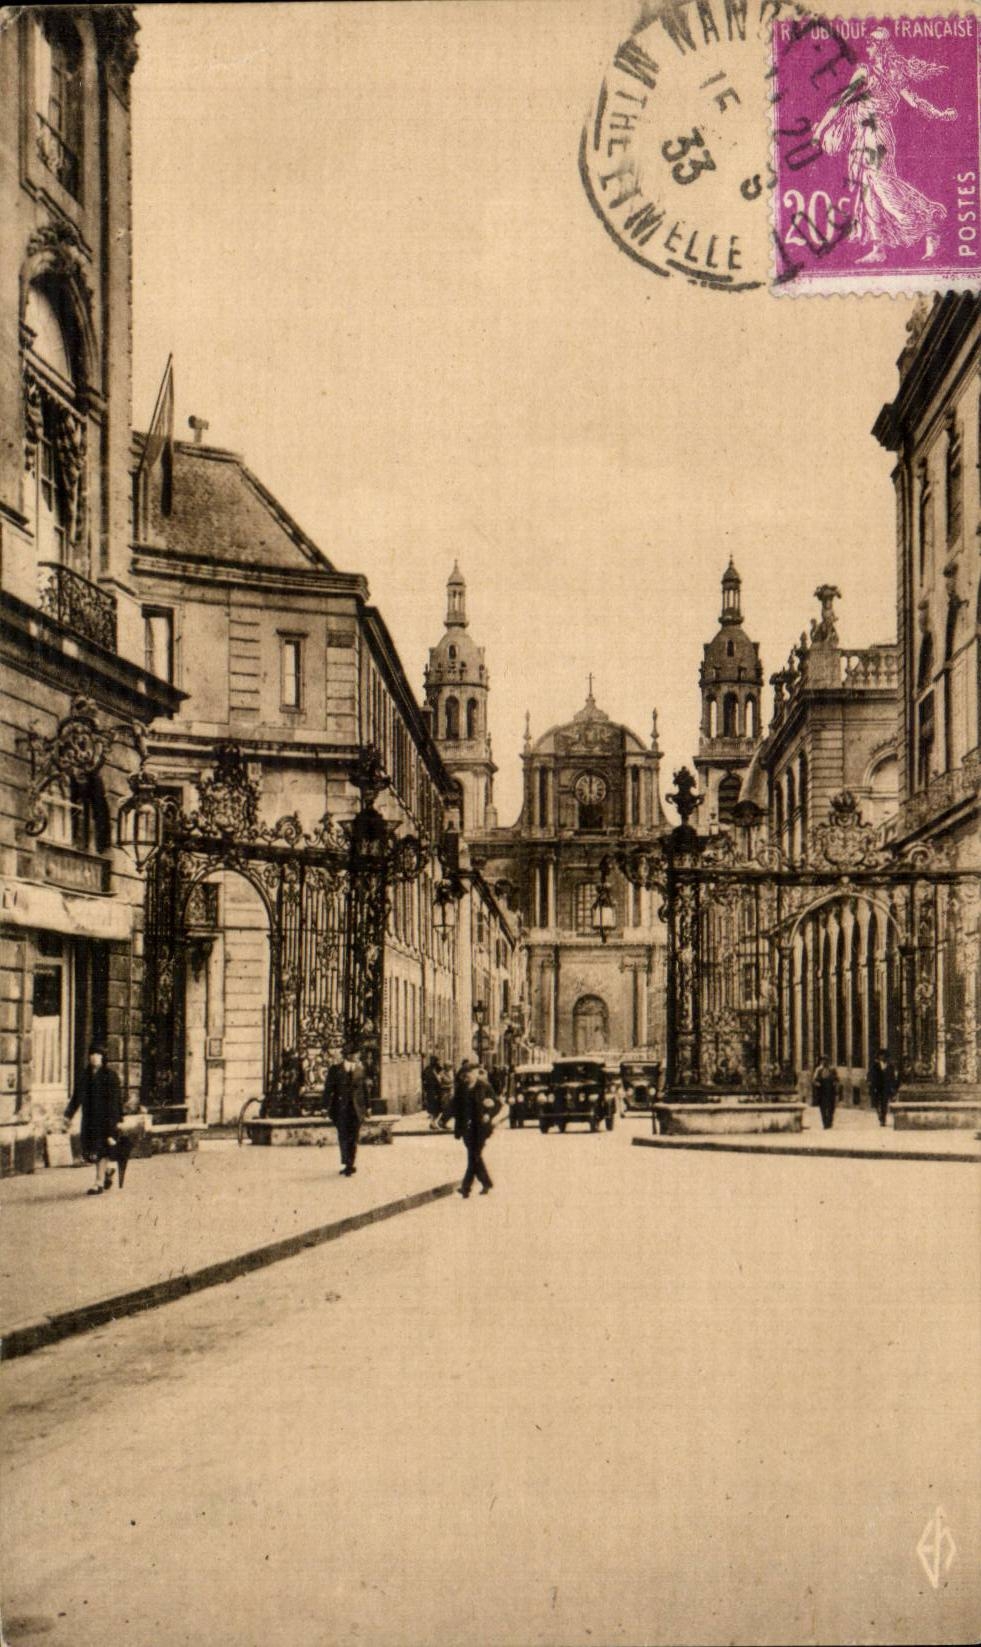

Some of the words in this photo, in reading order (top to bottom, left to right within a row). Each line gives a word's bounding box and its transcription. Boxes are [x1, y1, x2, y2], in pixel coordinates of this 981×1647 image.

[894, 19, 974, 40] FRANÇAISE
[661, 126, 717, 185] 33
[956, 170, 977, 257] POSTES
